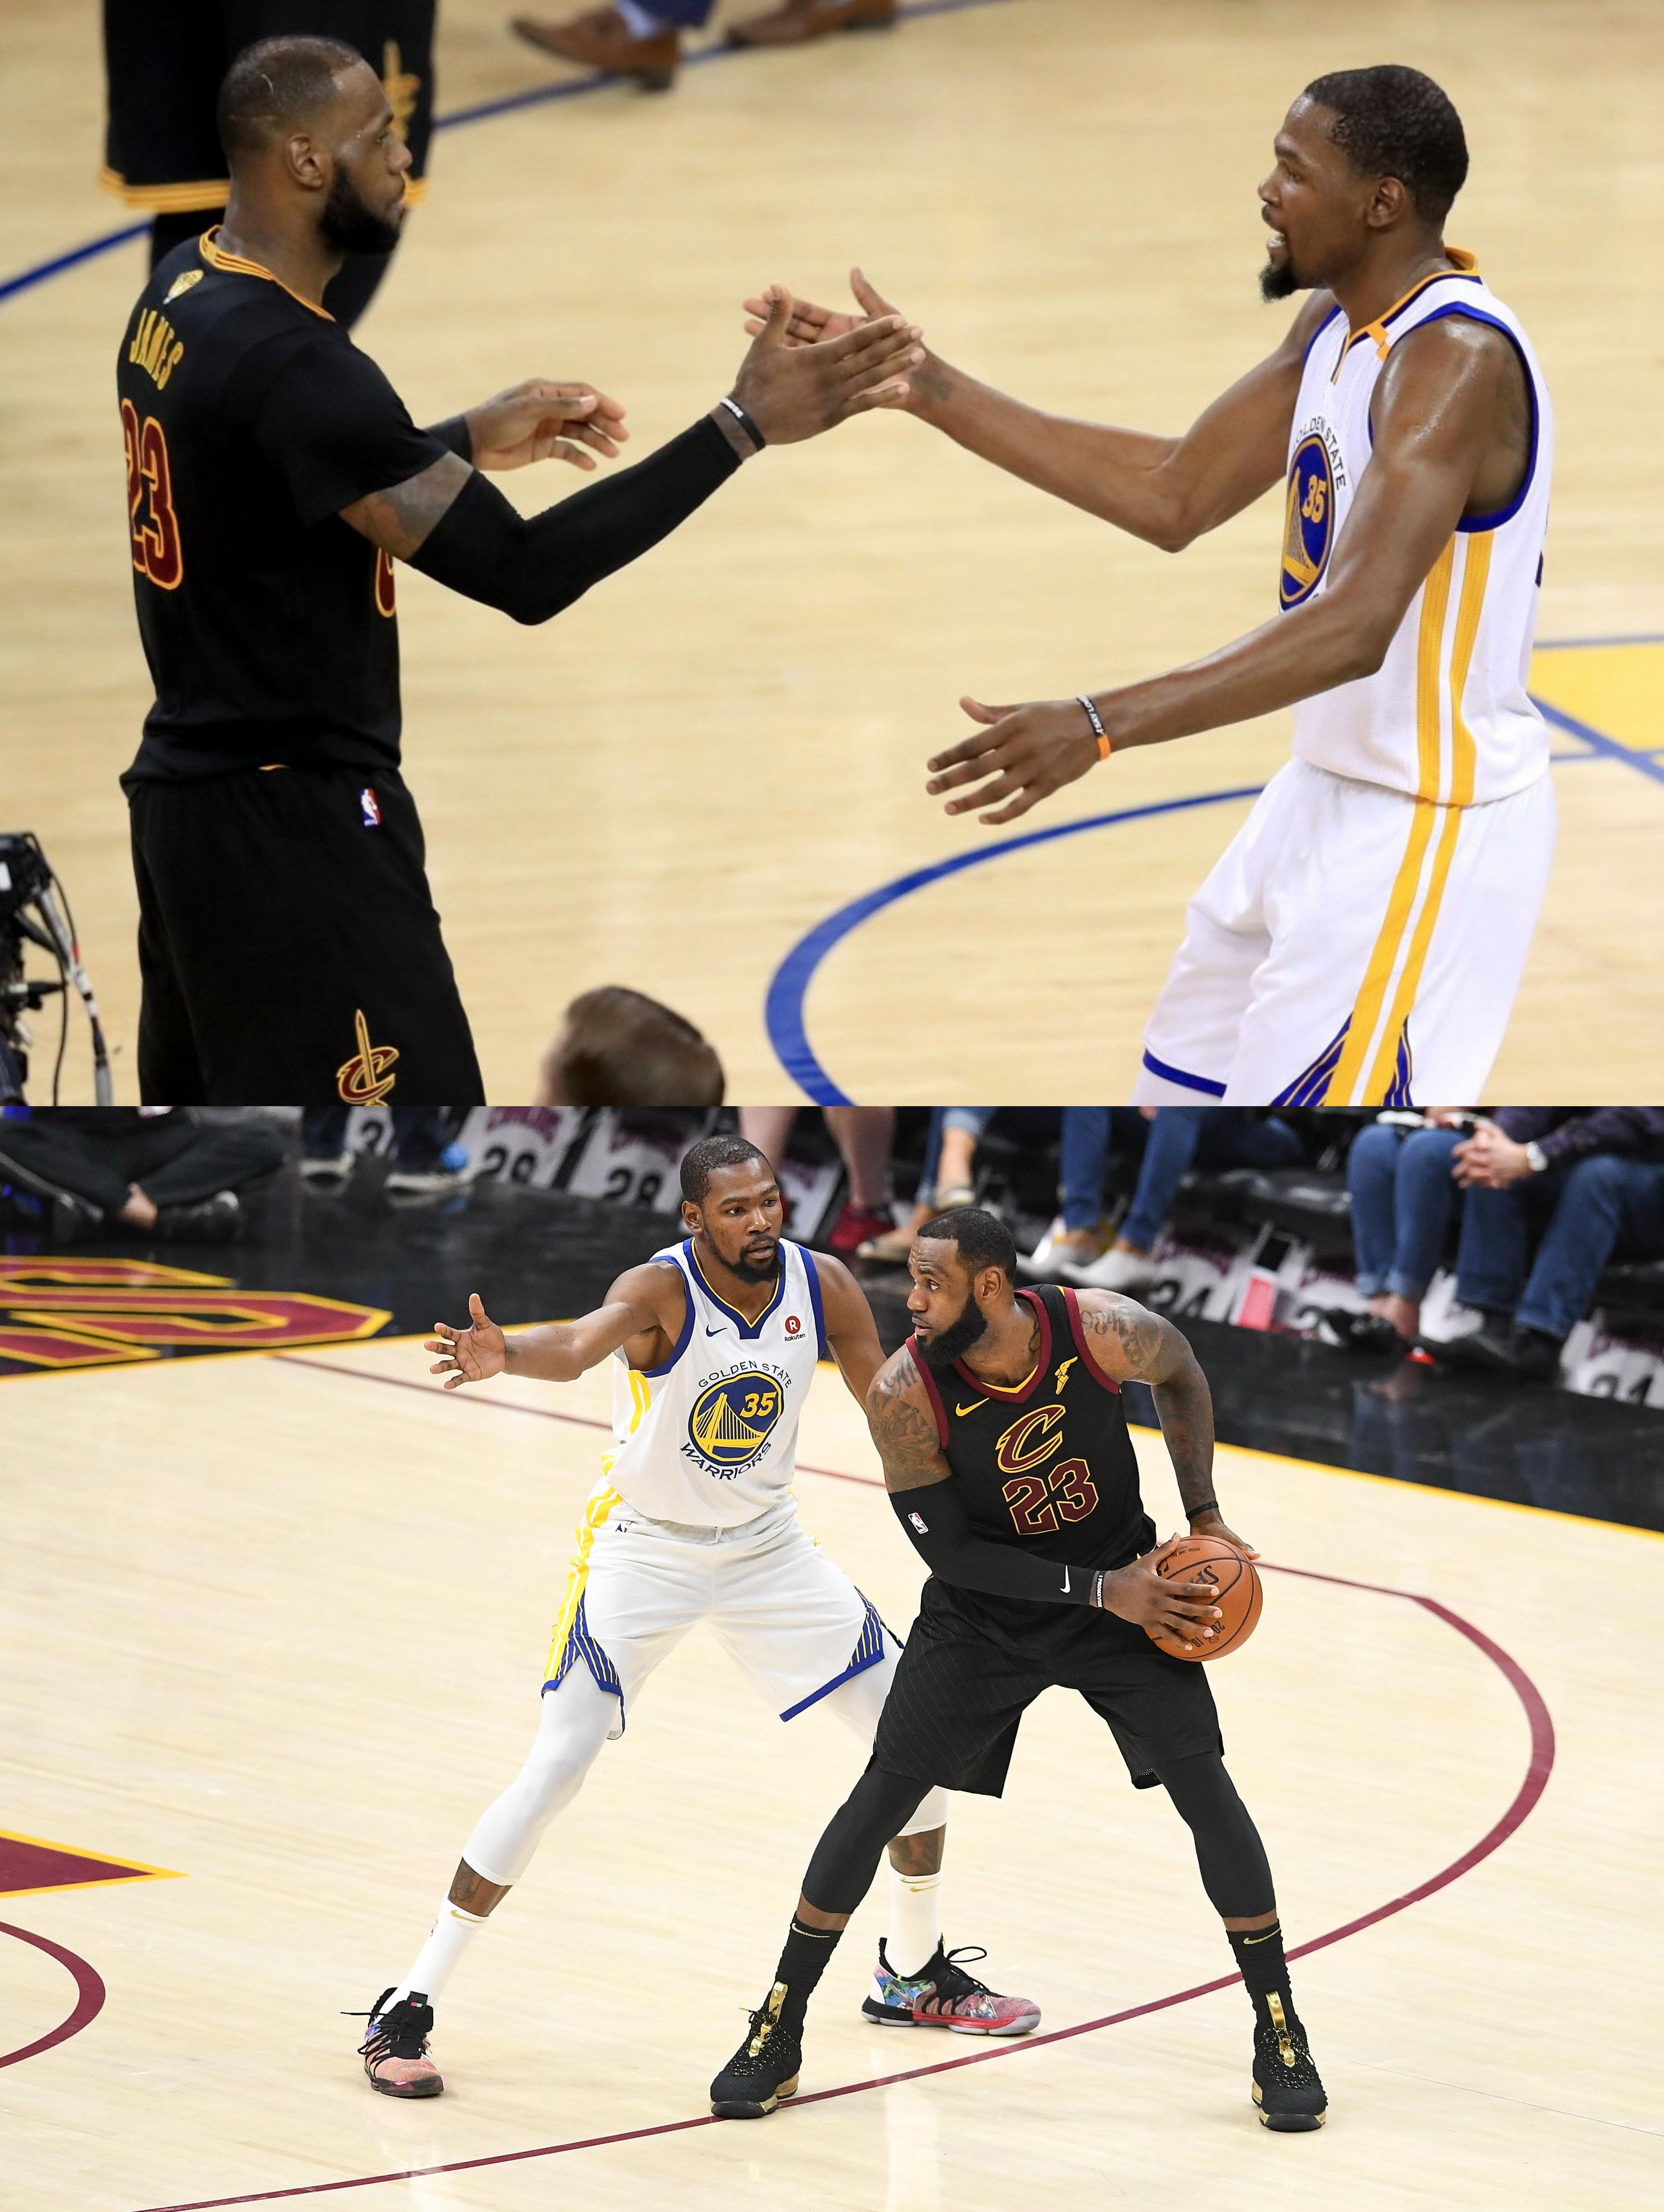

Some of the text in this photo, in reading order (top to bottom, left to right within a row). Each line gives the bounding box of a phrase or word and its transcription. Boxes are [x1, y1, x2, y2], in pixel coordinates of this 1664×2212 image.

[129, 307, 184, 390] JAMES
[1294, 416, 1346, 490] OLDEN STATE
[122, 398, 183, 590] 23
[1301, 474, 1327, 523] 35
[699, 1361, 792, 1388] GOLDEN STATE
[740, 1391, 777, 1418] 35
[680, 1441, 771, 1481] WARRIORS
[1002, 1458, 1099, 1535] 23
